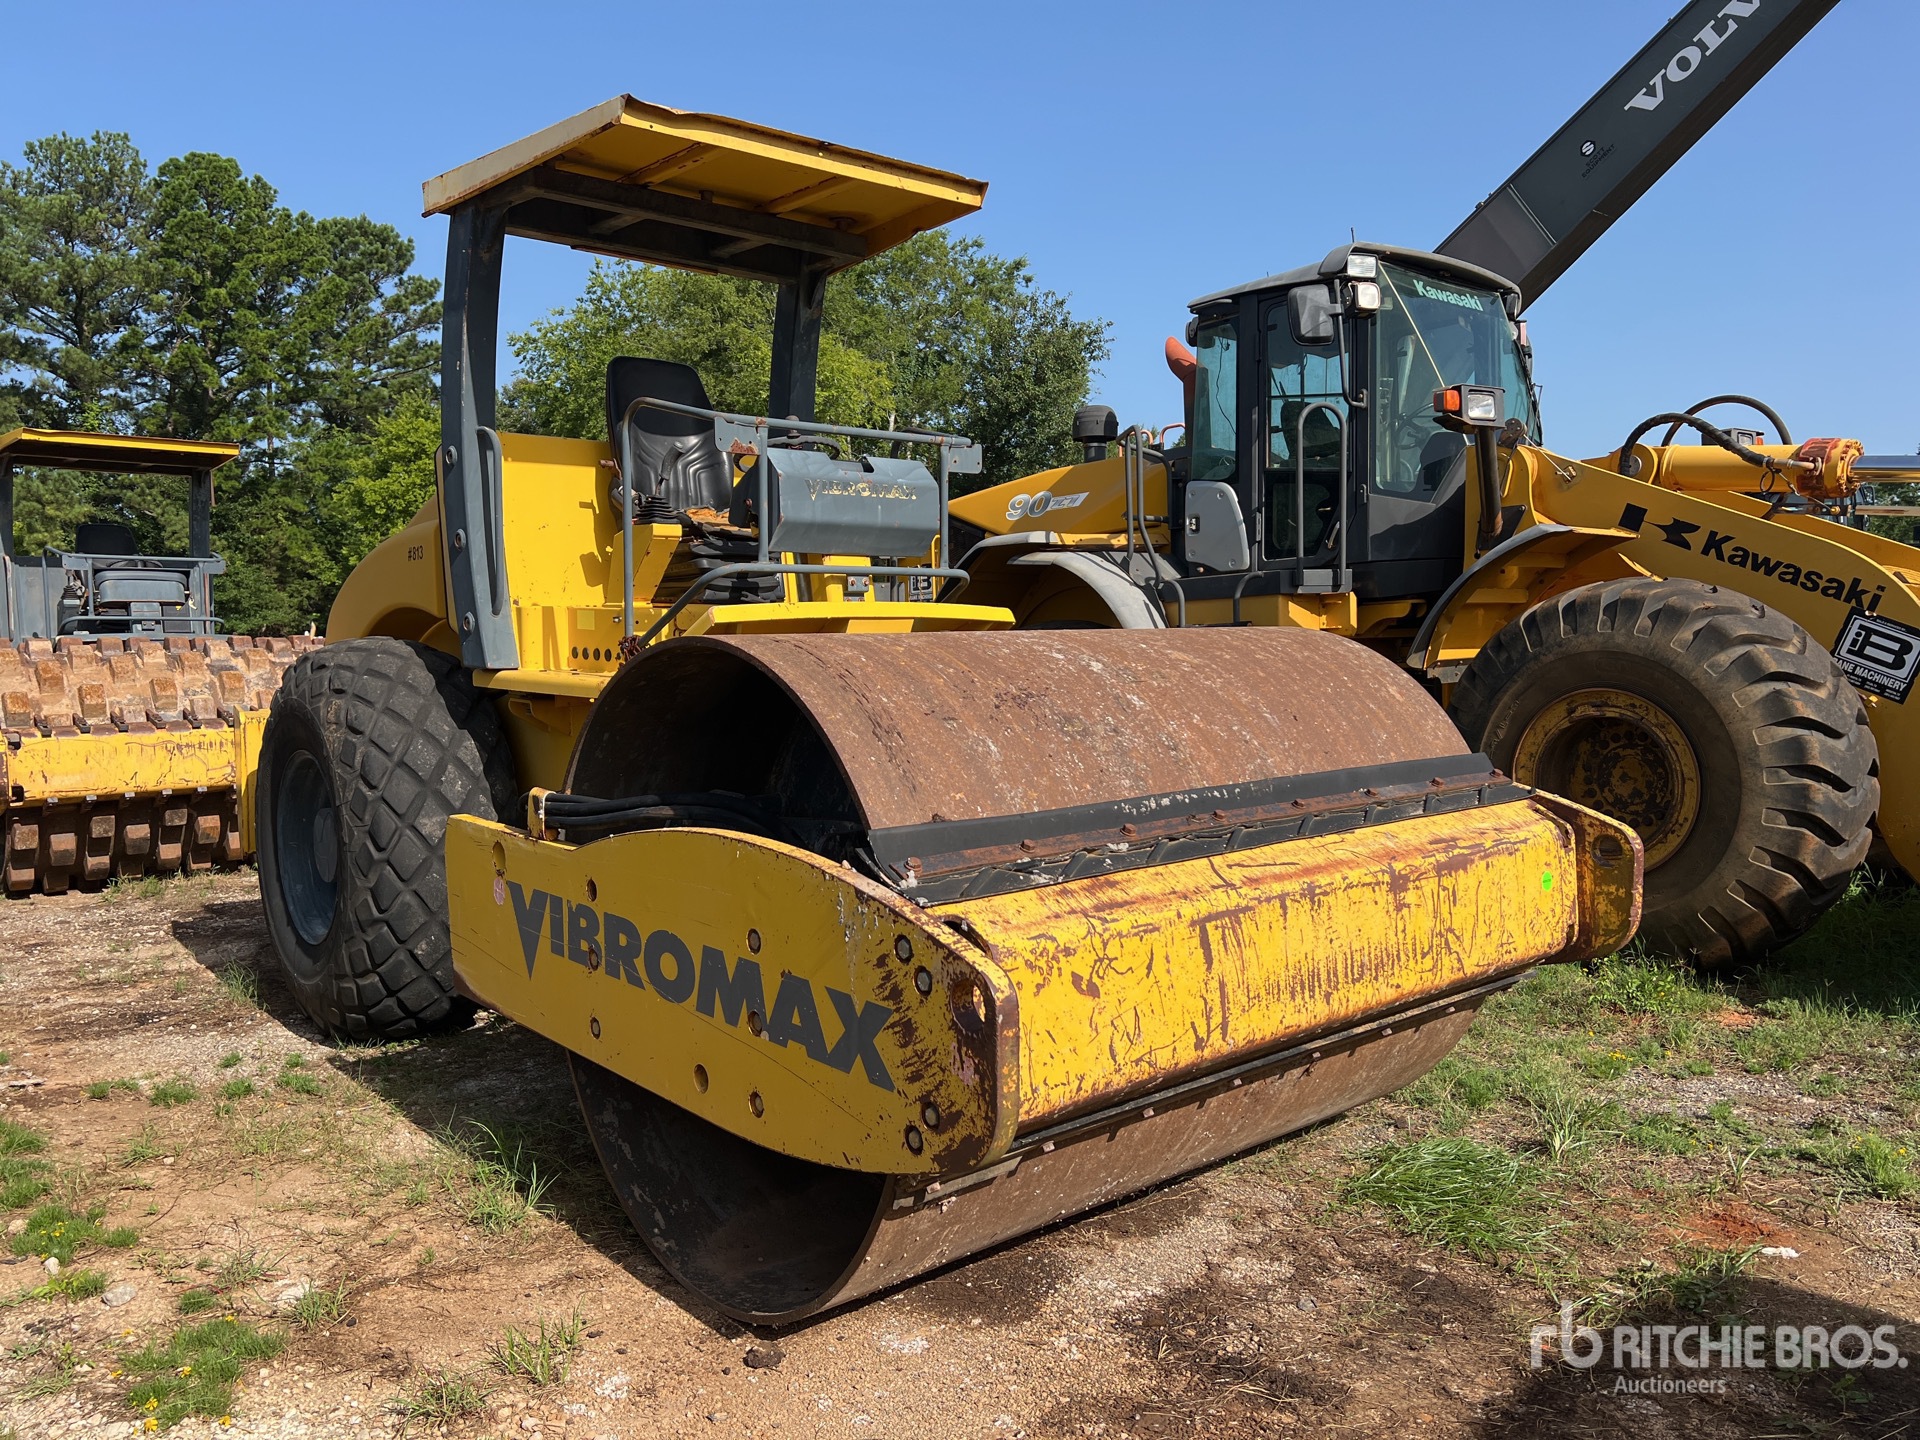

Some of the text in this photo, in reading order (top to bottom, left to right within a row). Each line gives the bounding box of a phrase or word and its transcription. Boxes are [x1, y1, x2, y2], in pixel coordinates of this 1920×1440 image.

[1412, 279, 1484, 311] Kawasaki
[804, 478, 917, 501] VIBROMAX
[407, 545, 424, 562] #813
[1700, 529, 1887, 614] Kawasaki
[1854, 665, 1908, 692] MACHINERY
[506, 880, 895, 1093] VIBROMAX
